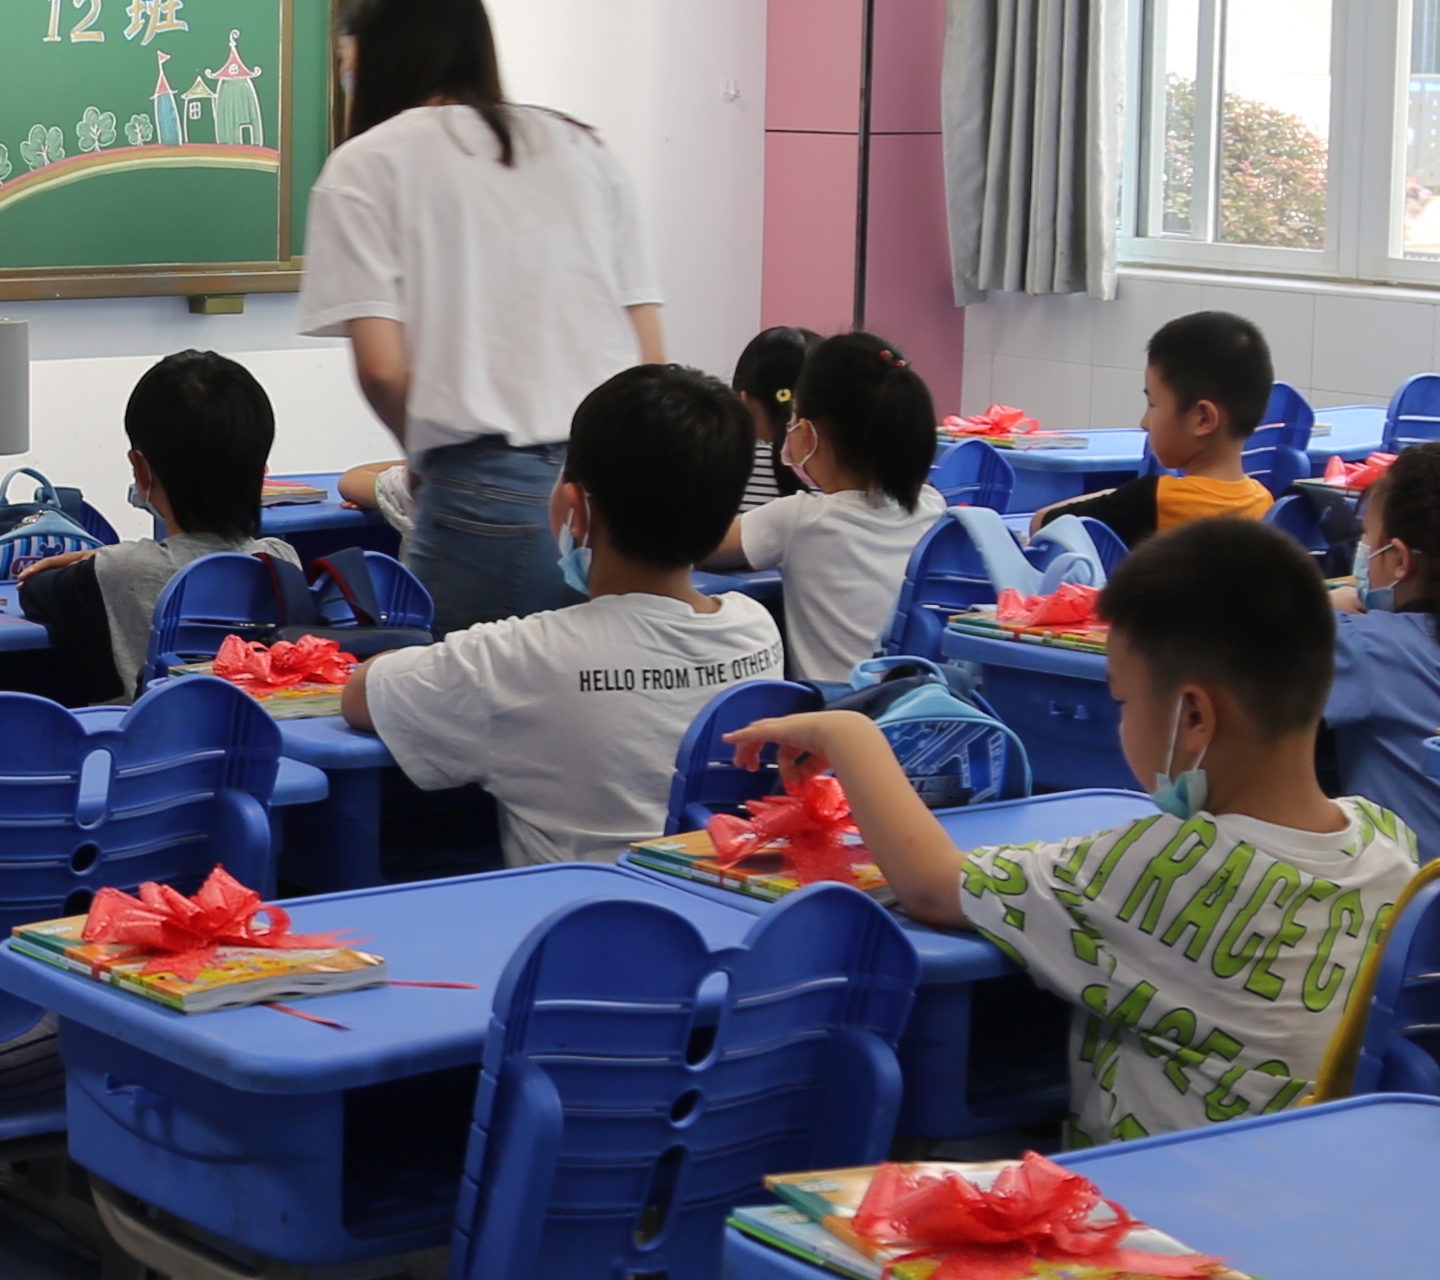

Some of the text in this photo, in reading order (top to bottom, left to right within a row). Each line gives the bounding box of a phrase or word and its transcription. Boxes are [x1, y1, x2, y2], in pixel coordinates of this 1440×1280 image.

[579, 669, 635, 692] HELLO
[642, 667, 690, 690] FROM
[695, 663, 728, 687] THE
[732, 649, 772, 680] OTHER
